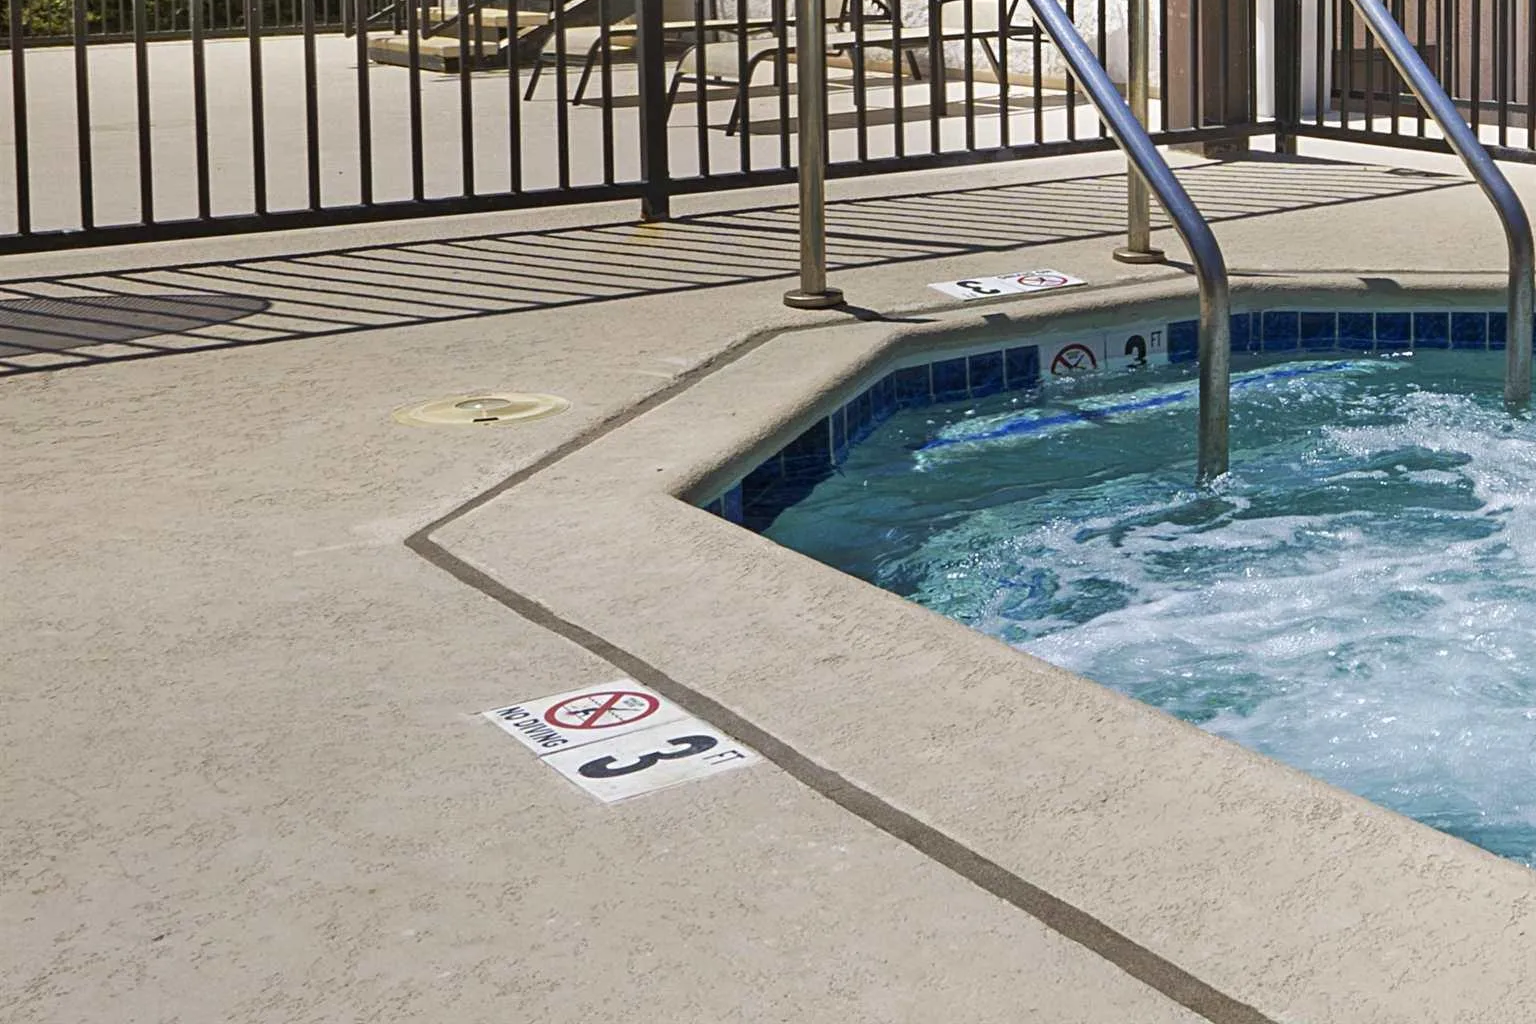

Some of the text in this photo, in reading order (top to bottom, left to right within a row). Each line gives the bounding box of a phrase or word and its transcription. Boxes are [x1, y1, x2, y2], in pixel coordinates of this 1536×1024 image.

[956, 280, 1001, 295] 3
[1151, 330, 1162, 347] FT
[496, 706, 569, 749] NO DIVING
[577, 734, 746, 779] 3 FT
